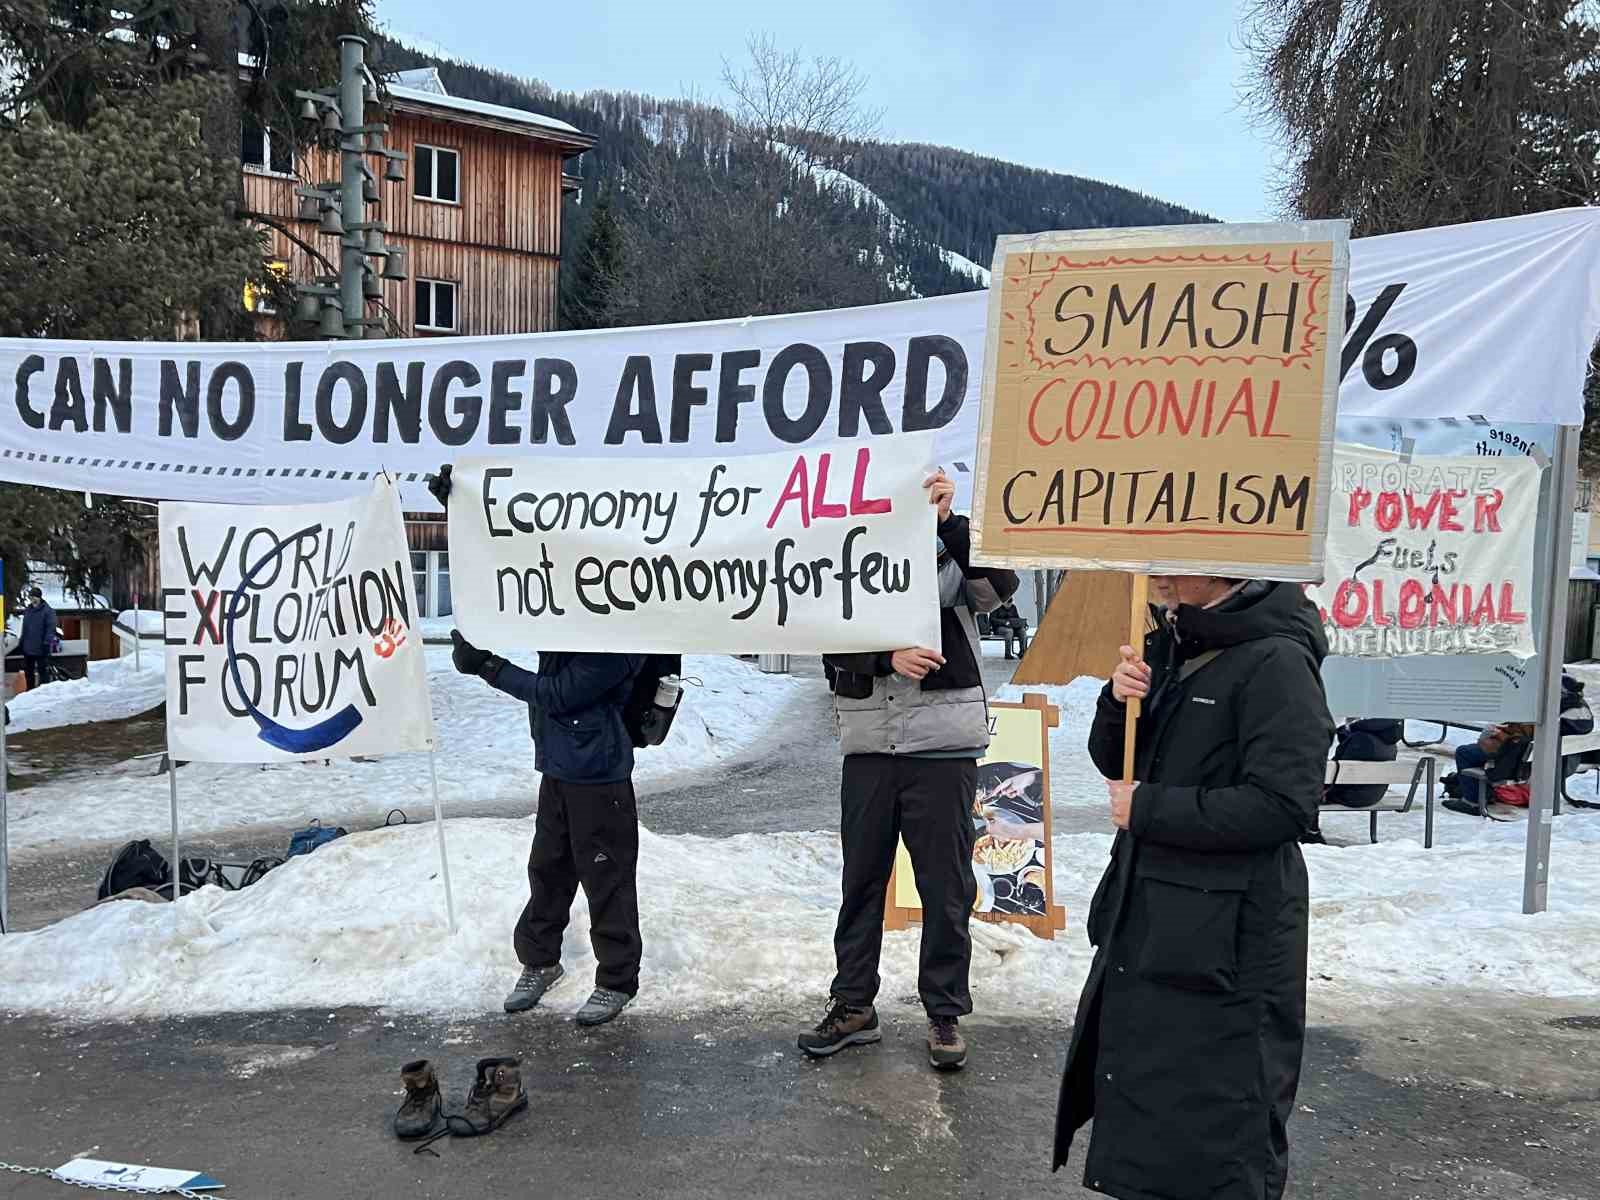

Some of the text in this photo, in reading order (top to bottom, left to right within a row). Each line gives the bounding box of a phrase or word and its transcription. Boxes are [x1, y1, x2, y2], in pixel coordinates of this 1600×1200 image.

[1044, 281, 1299, 356] SMASH
[15, 354, 132, 432] CAN
[158, 359, 256, 442] NO
[283, 357, 578, 446] LONGER
[604, 333, 969, 445] AFFORD
[1028, 376, 1292, 446] COLONIAL
[483, 447, 892, 548] Economy for ALL
[1003, 468, 1311, 531] CAPITALISM
[1332, 462, 1498, 495] RPORATE
[1348, 487, 1504, 533] POWER
[497, 526, 911, 627] not economy for few
[1366, 537, 1458, 575] Fuels
[178, 647, 377, 718] FORUM
